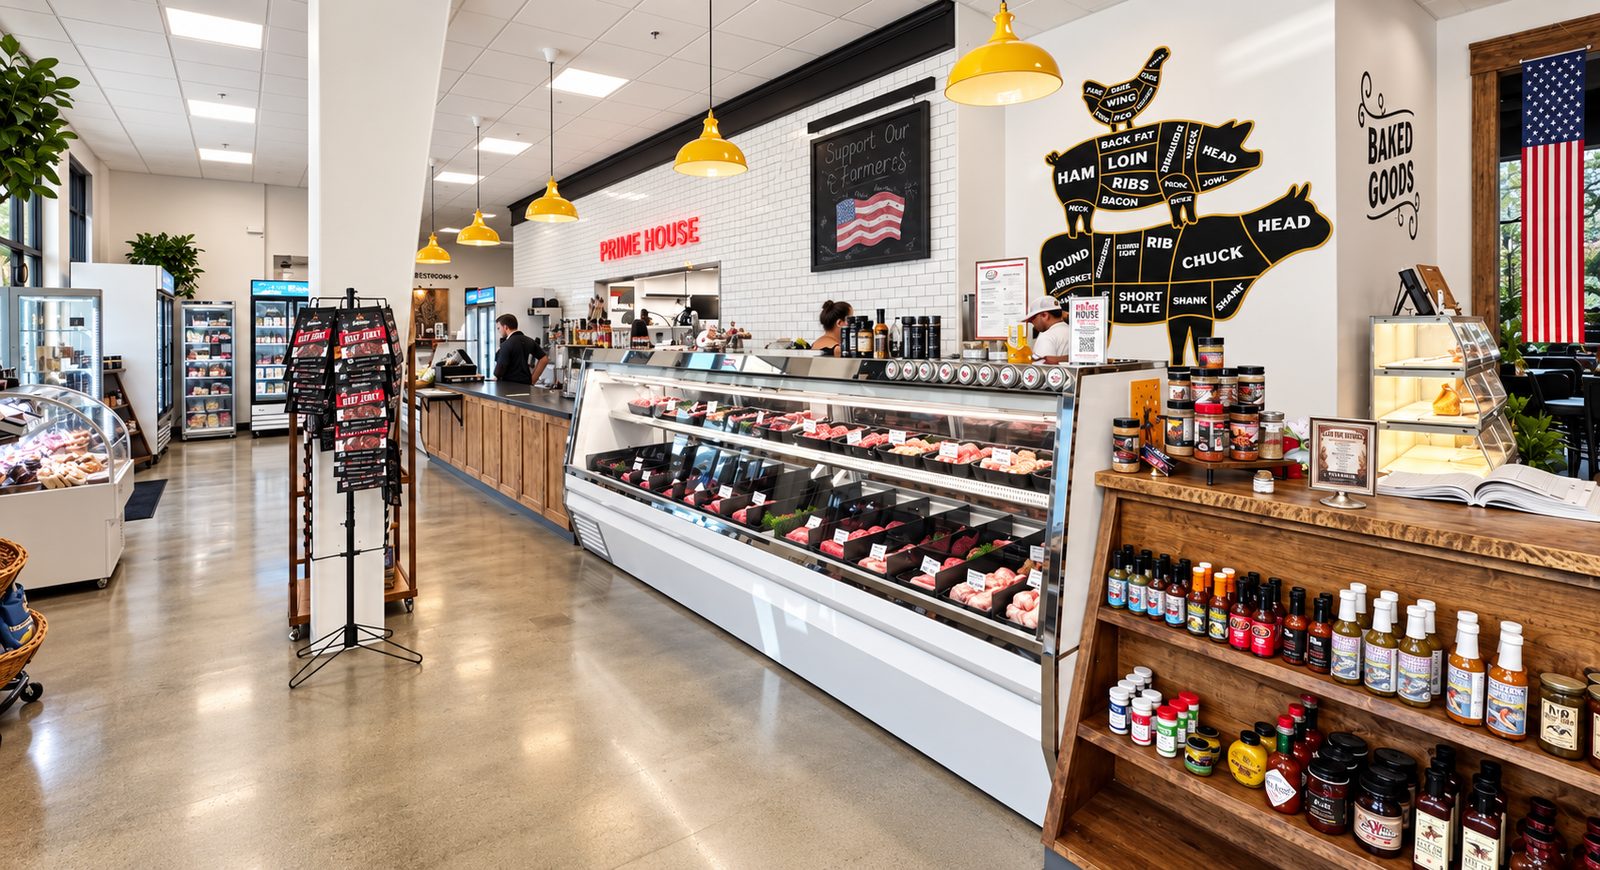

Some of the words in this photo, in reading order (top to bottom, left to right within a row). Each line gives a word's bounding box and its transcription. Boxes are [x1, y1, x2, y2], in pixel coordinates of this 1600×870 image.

[1106, 93, 1136, 108] WING
[825, 130, 876, 166] Support
[884, 123, 910, 144] Our
[1101, 135, 1131, 149] BACK
[1134, 130, 1155, 142] FAT
[1368, 121, 1413, 165] BAKED
[1107, 151, 1148, 170] LOIN
[1202, 145, 1237, 164] HEAD
[1057, 165, 1095, 185] HAM
[1112, 177, 1149, 191] RIBS
[1202, 175, 1228, 187] JOWL
[1368, 159, 1414, 209] GOODS
[1101, 195, 1138, 207] BACON
[1257, 215, 1311, 233] HEAD
[600, 232, 641, 262] PRIME
[644, 216, 700, 252] HOUSE
[1146, 236, 1173, 249] RIB
[1047, 248, 1090, 276] ROUND
[1182, 245, 1244, 269] CHUCK
[1118, 291, 1163, 302] SHORT
[1172, 296, 1208, 305] SHANK
[1120, 303, 1161, 313] PLATE
